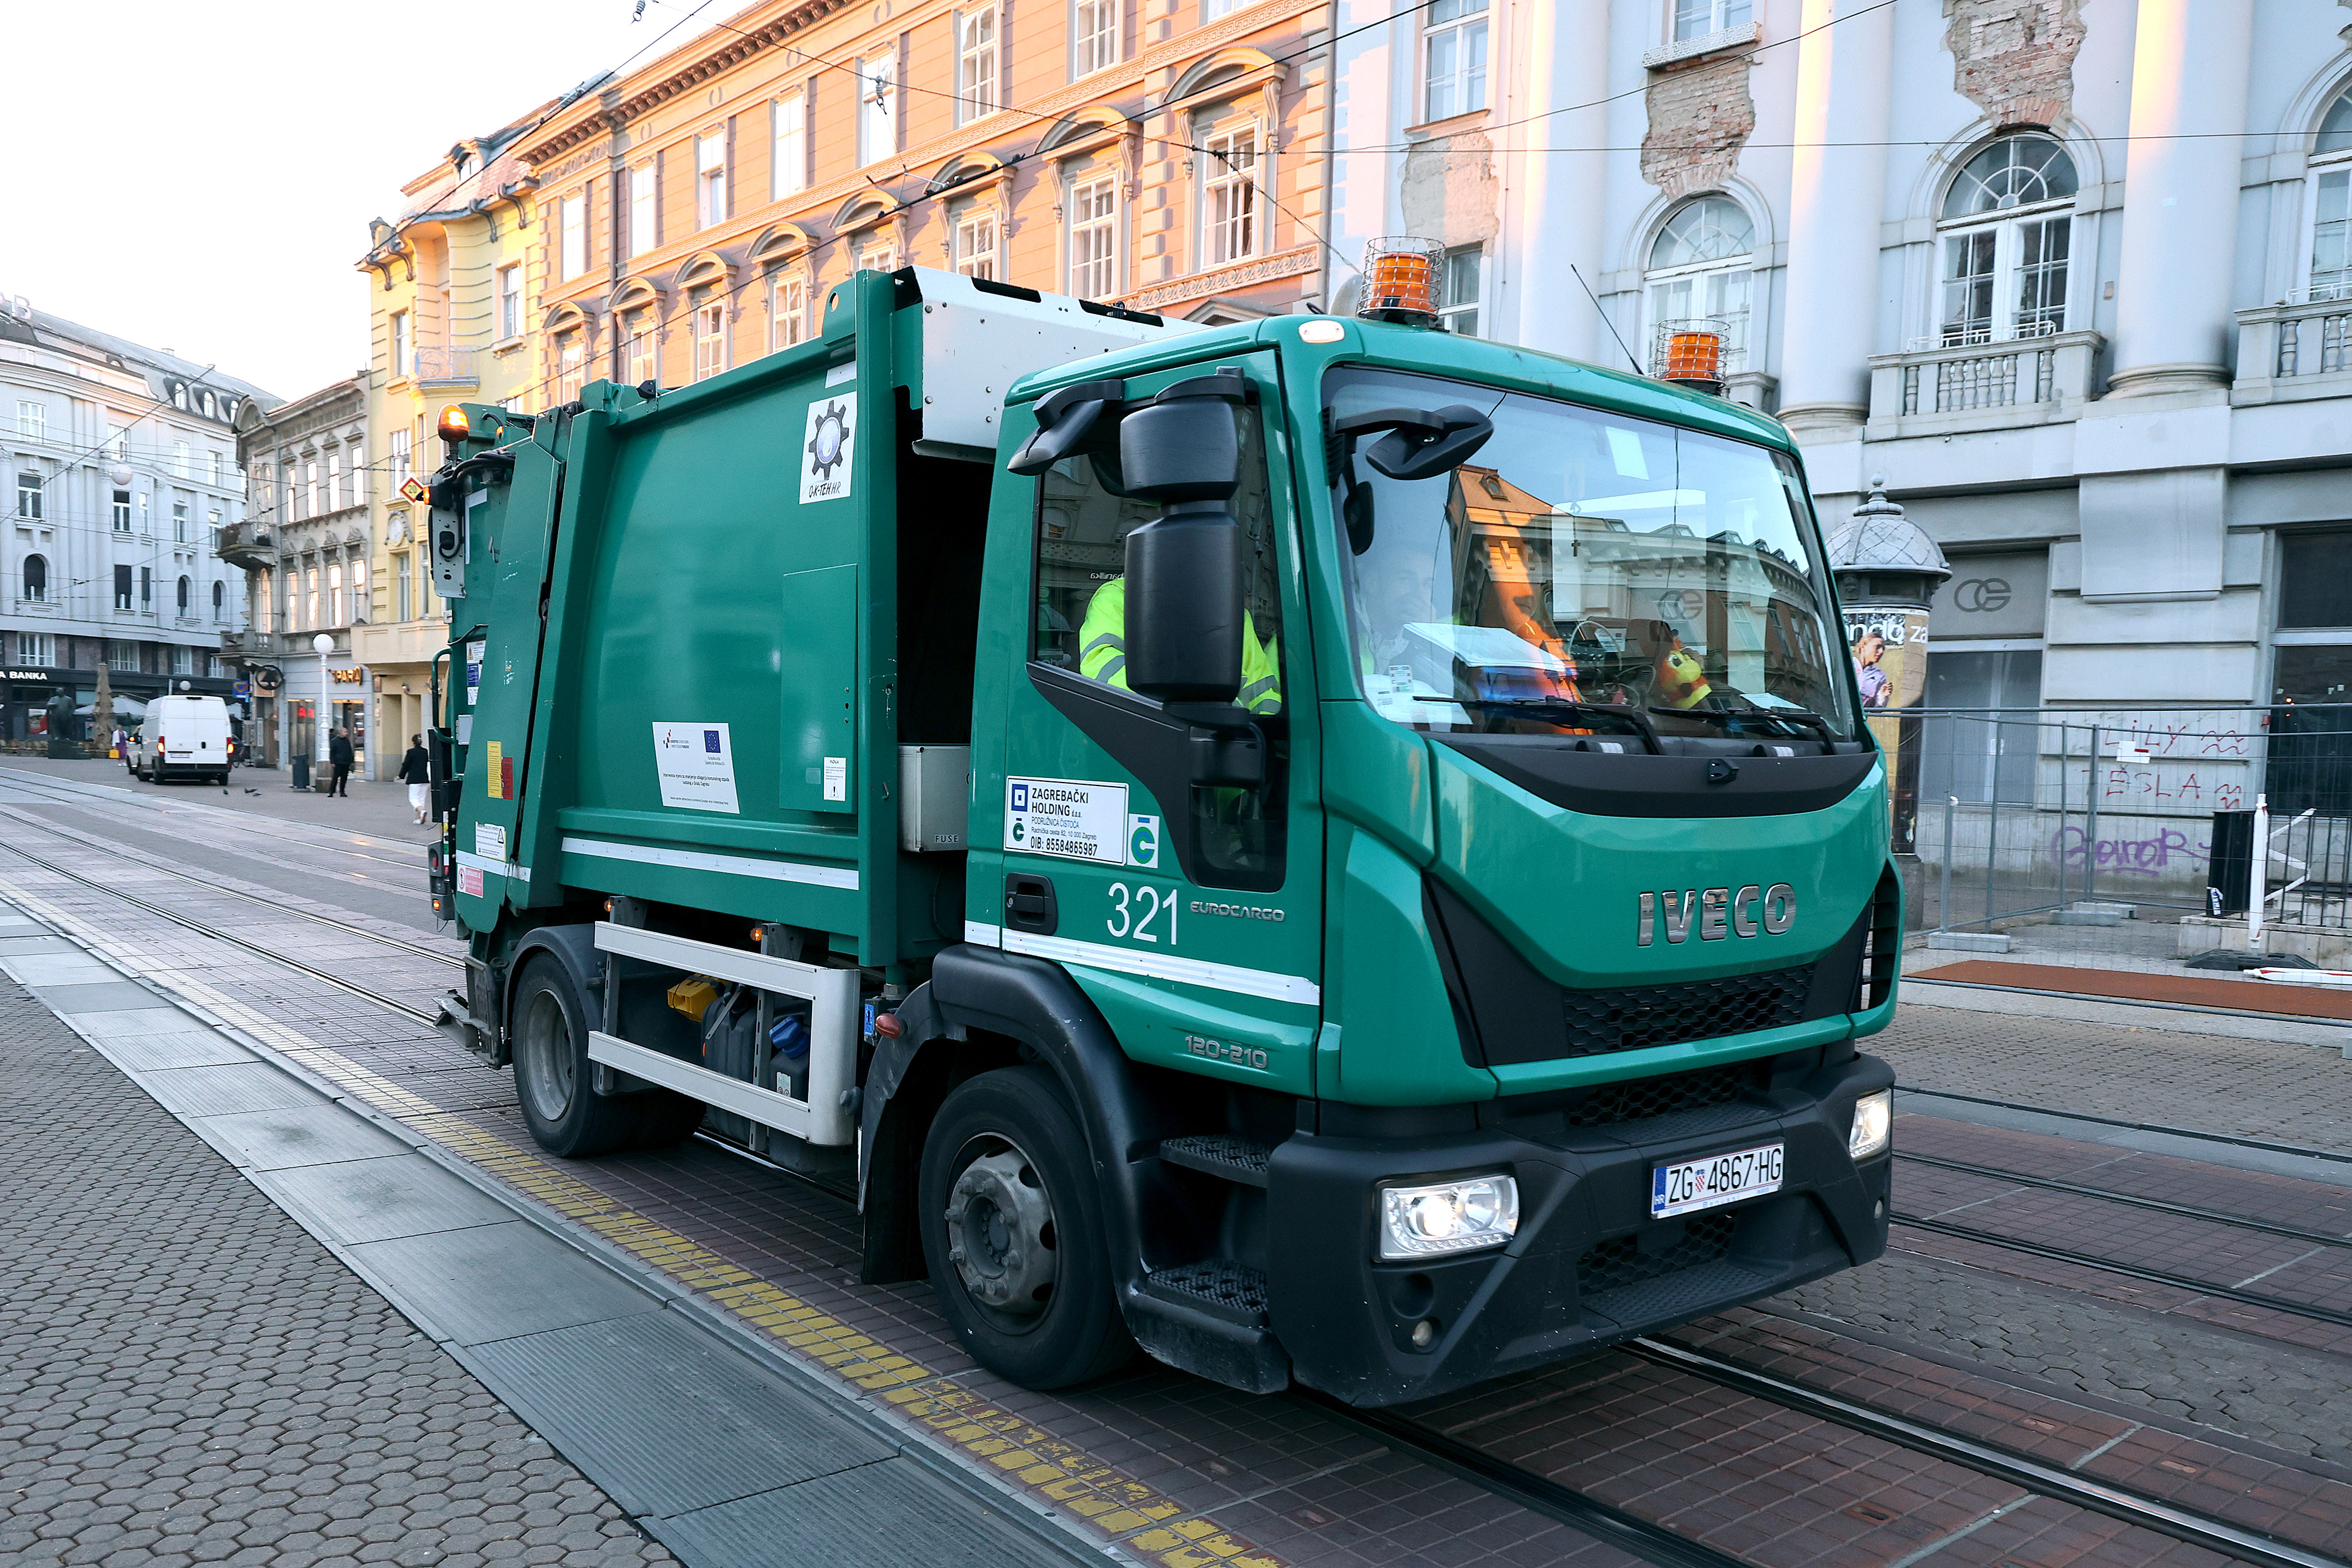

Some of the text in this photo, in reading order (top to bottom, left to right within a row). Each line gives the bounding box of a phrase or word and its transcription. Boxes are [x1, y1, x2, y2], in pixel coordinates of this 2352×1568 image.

[9, 671, 48, 680] BANKA
[1032, 788, 1089, 804] ZAGREBAČKI
[1031, 802, 1070, 816] HOLDING
[1031, 816, 1059, 827] PODRUŽNICA
[935, 835, 959, 843] FUSE
[1082, 832, 1097, 841] Zagreb
[1030, 836, 1098, 857] OIB: 85584865987
[1107, 882, 1177, 945] 321
[1190, 901, 1285, 922] EUROCARGO
[1638, 882, 1797, 947] IVECO
[1185, 1035, 1268, 1069] 120-210
[1669, 1166, 1693, 1203] ZG
[1654, 1194, 1665, 1206] HR
